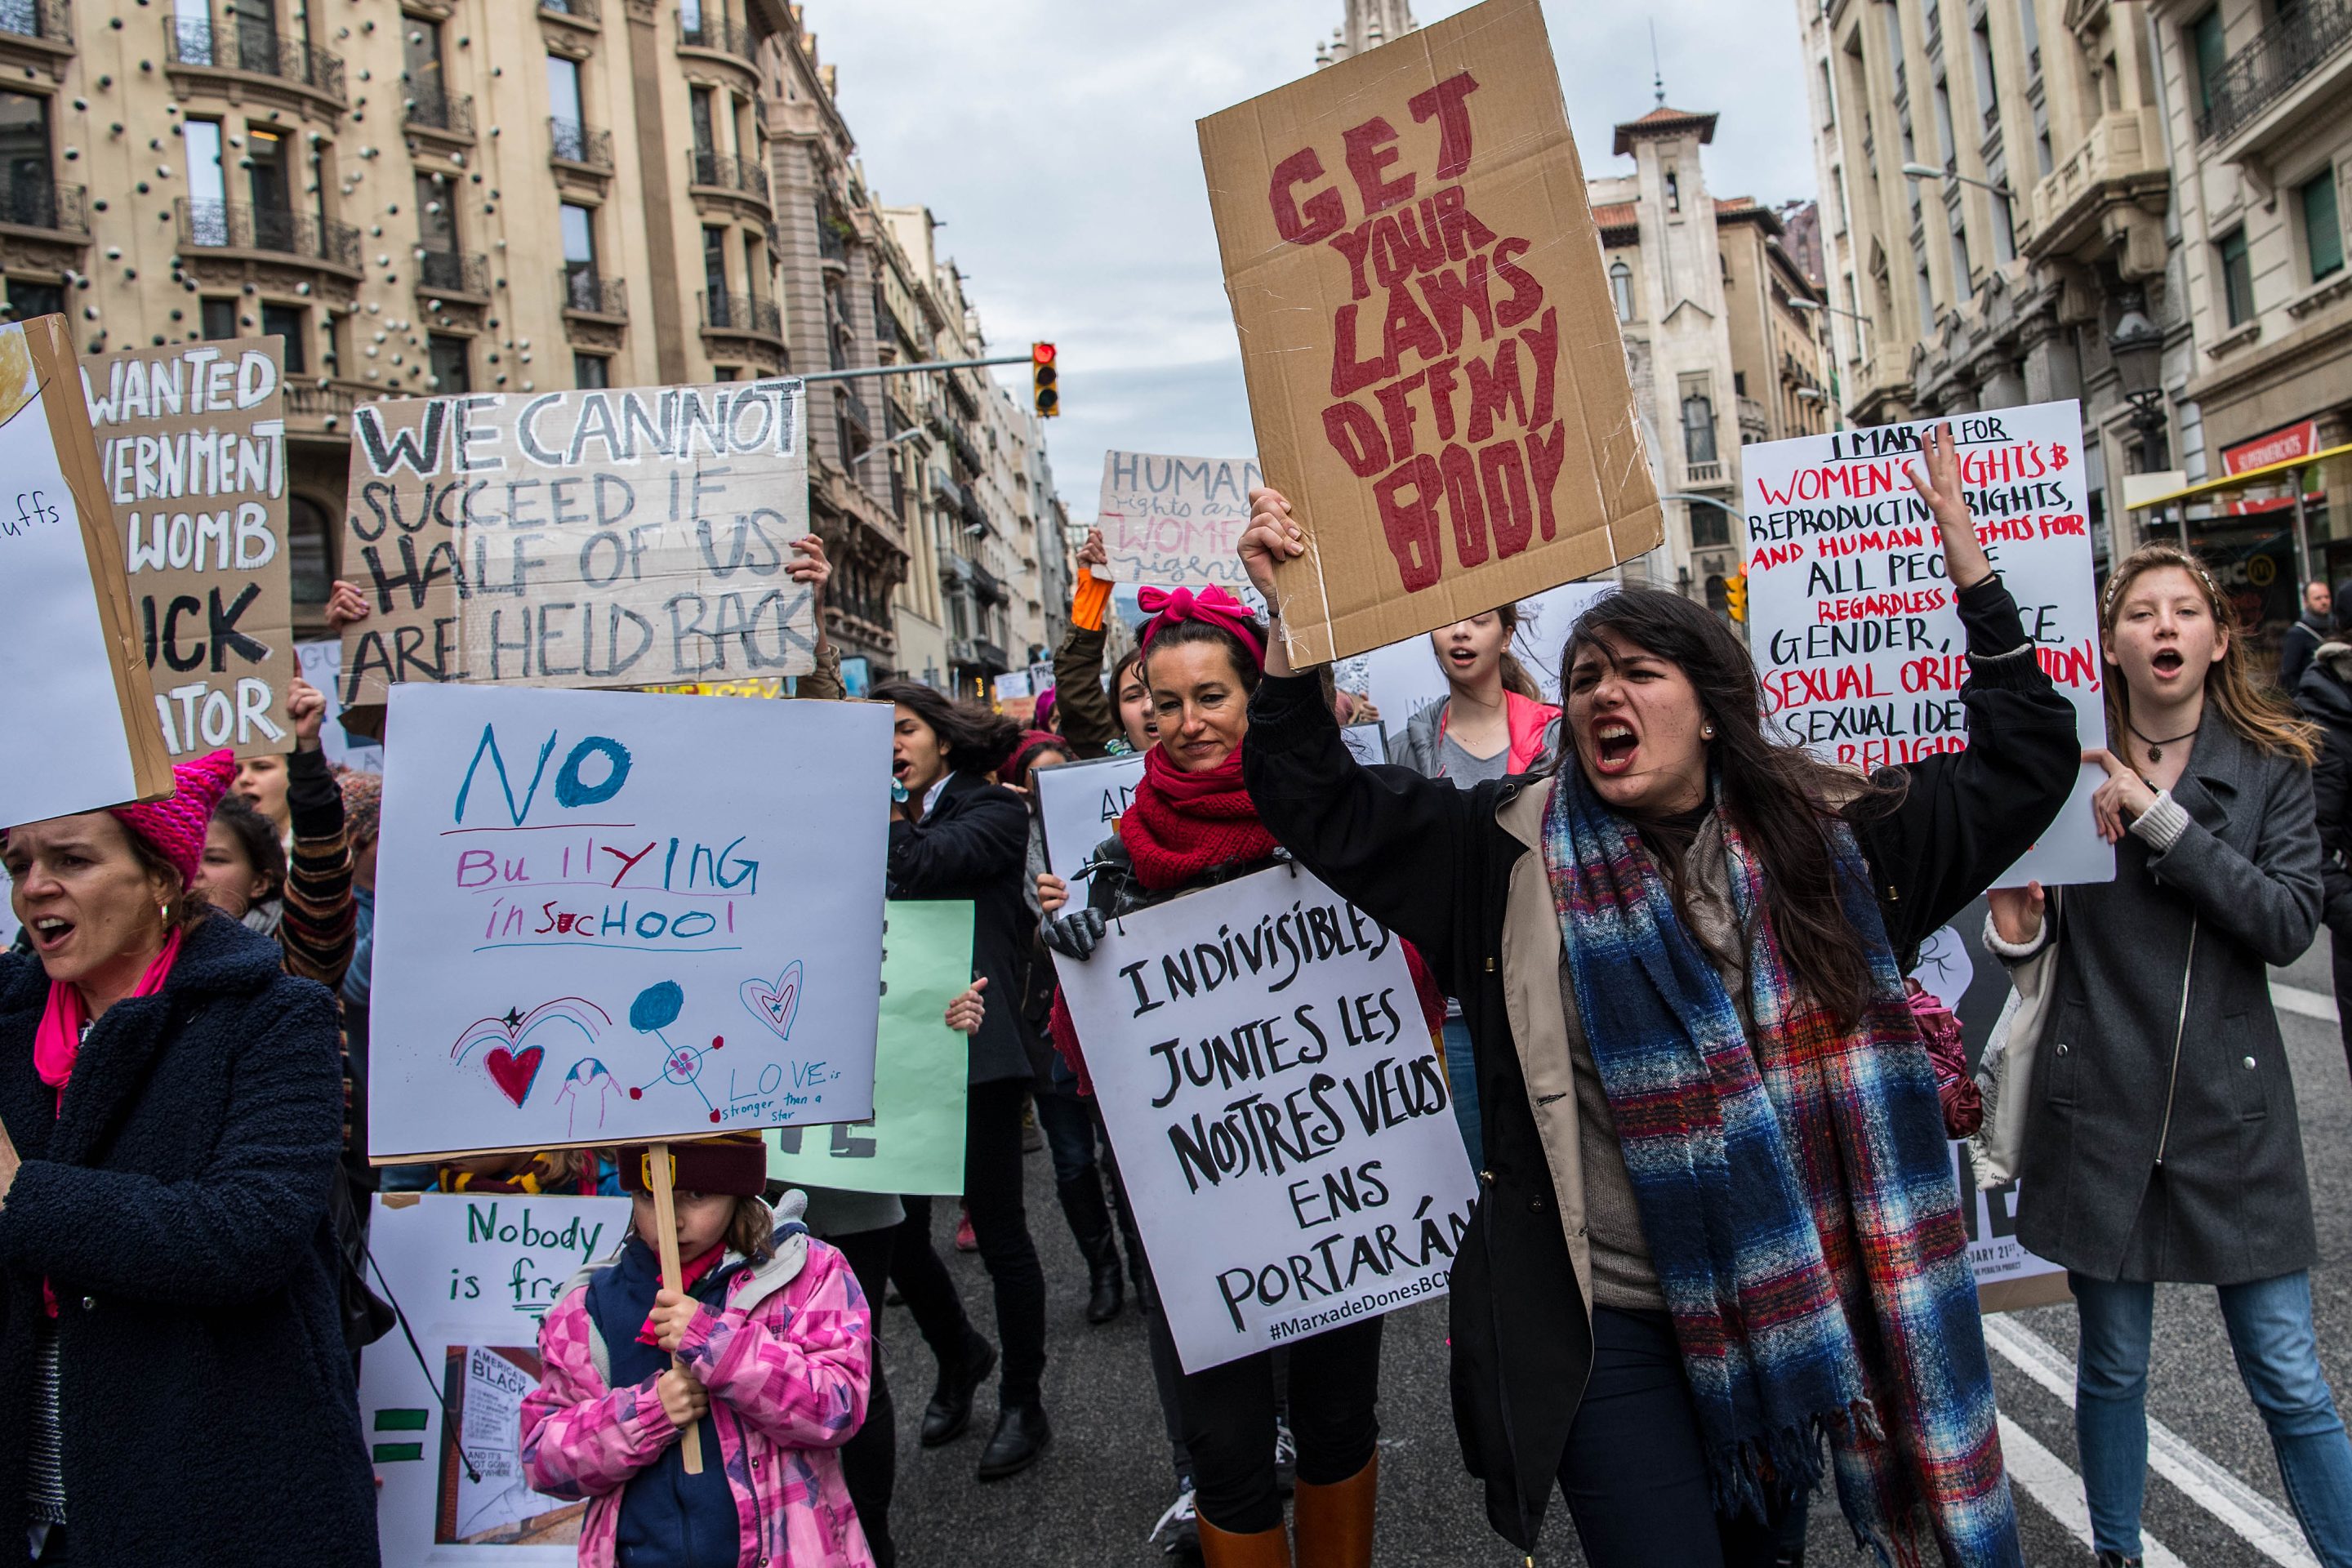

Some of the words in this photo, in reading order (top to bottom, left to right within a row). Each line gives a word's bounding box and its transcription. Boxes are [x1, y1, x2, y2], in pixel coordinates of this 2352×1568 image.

[1269, 71, 1479, 245] GET
[1329, 185, 1498, 301] YOUR
[1330, 236, 1544, 398] LAWS
[1321, 355, 1460, 478] OFF
[1464, 306, 1557, 443] MY
[353, 394, 507, 479] WE
[515, 377, 807, 467] CANNOT
[1831, 435, 1842, 460] I
[1962, 416, 2007, 443] FOR
[350, 471, 636, 541] SUCCEED
[669, 466, 733, 523] IF
[1111, 495, 1192, 517] rights
[1373, 418, 1565, 594] BODY
[1757, 457, 1915, 506] WOMEN'S
[0, 491, 60, 537] uffs
[127, 501, 278, 573] WOMB
[1104, 510, 1241, 555] WOME
[1748, 497, 1931, 542] REPRODUCTIV
[361, 534, 546, 615] HALF
[580, 523, 662, 589] OF
[697, 507, 788, 579] US
[1750, 542, 1803, 572] AND
[1818, 527, 1923, 559] HUMAN
[2038, 514, 2086, 541] FOR
[1806, 558, 1877, 598] ALL
[1818, 587, 1945, 625] REGARDLESS
[346, 617, 471, 703] ARE
[492, 601, 653, 680] HELD
[662, 589, 816, 676] BACK
[1771, 617, 1950, 666] GENDER,
[1759, 662, 1894, 718] SEXUAL
[1785, 702, 1908, 748] SEXUAL
[1913, 699, 1969, 737] IDE
[455, 723, 634, 826] NO
[486, 898, 523, 938] in
[1150, 1003, 1329, 1108] JUNTES
[1337, 987, 1401, 1047] LES
[730, 1061, 826, 1102] LOVE
[831, 1070, 841, 1079] is
[722, 1099, 774, 1120] stronger
[783, 1093, 808, 1106] than
[772, 1108, 795, 1122] star
[1167, 1073, 1349, 1195] NOSTRES
[1343, 1054, 1447, 1137] VEUS
[1288, 1160, 1390, 1229] ENS
[467, 1201, 604, 1264] Nobody
[450, 1268, 480, 1300] is
[471, 1358, 526, 1398] BLACK
[473, 1349, 518, 1379] AMERICA
[468, 1451, 487, 1461] AND
